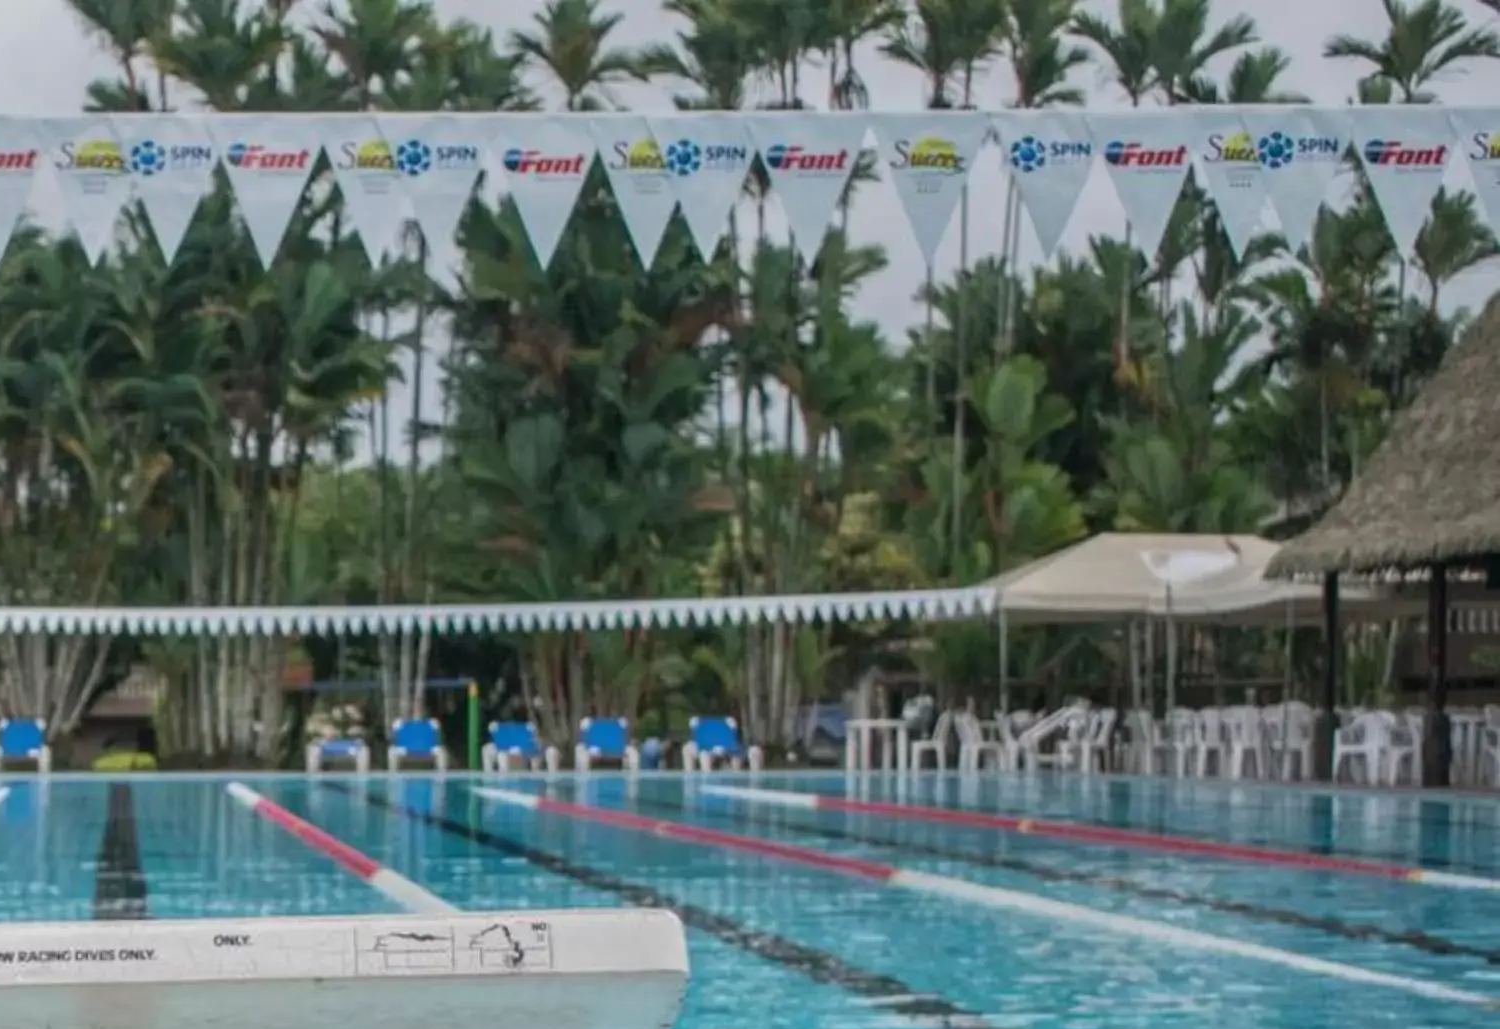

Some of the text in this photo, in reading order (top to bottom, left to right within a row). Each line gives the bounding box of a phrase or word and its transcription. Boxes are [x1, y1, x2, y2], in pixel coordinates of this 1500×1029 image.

[171, 145, 211, 160] SPIN
[436, 145, 477, 160] SPIN
[706, 145, 746, 160] SPIN
[1051, 142, 1091, 156] SPIN
[1298, 138, 1338, 154] SPIN
[17, 949, 72, 963] RACING
[75, 948, 115, 962] DIVES
